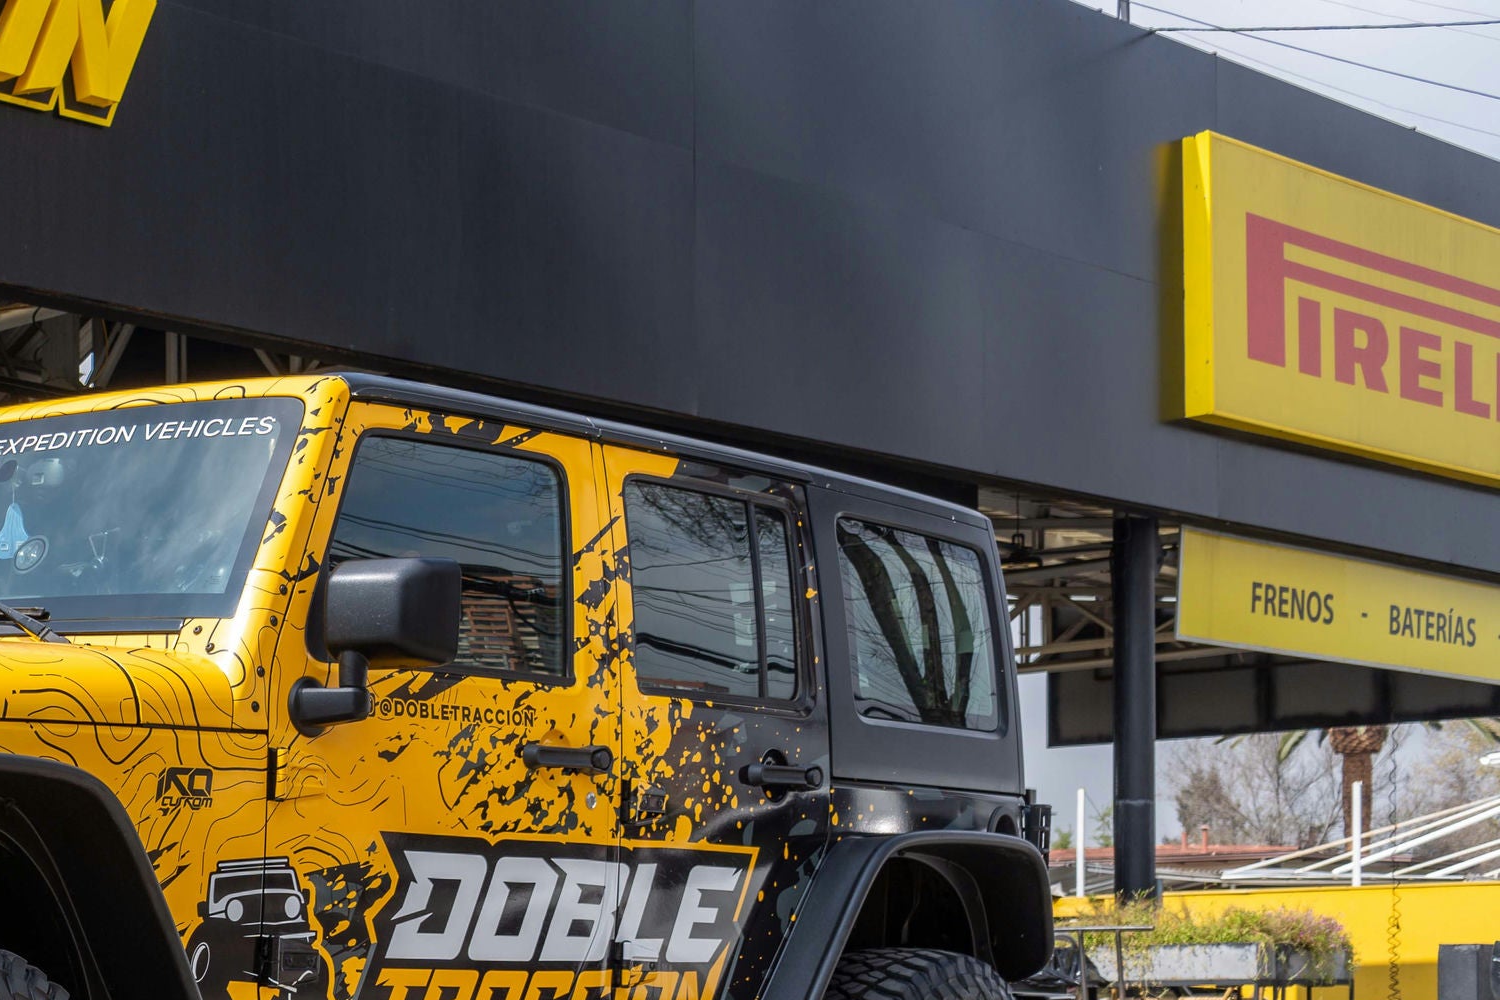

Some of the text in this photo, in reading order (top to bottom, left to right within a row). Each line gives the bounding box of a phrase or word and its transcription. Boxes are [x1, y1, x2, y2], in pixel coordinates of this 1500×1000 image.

[1246, 211, 1500, 424] PIREL
[143, 416, 276, 441] VEHICLES
[1250, 581, 1335, 625] FRENOS
[1388, 604, 1477, 647] BATERÍAS
[379, 697, 535, 728] @DOBLETRACCION
[384, 850, 744, 964] DOBLE
